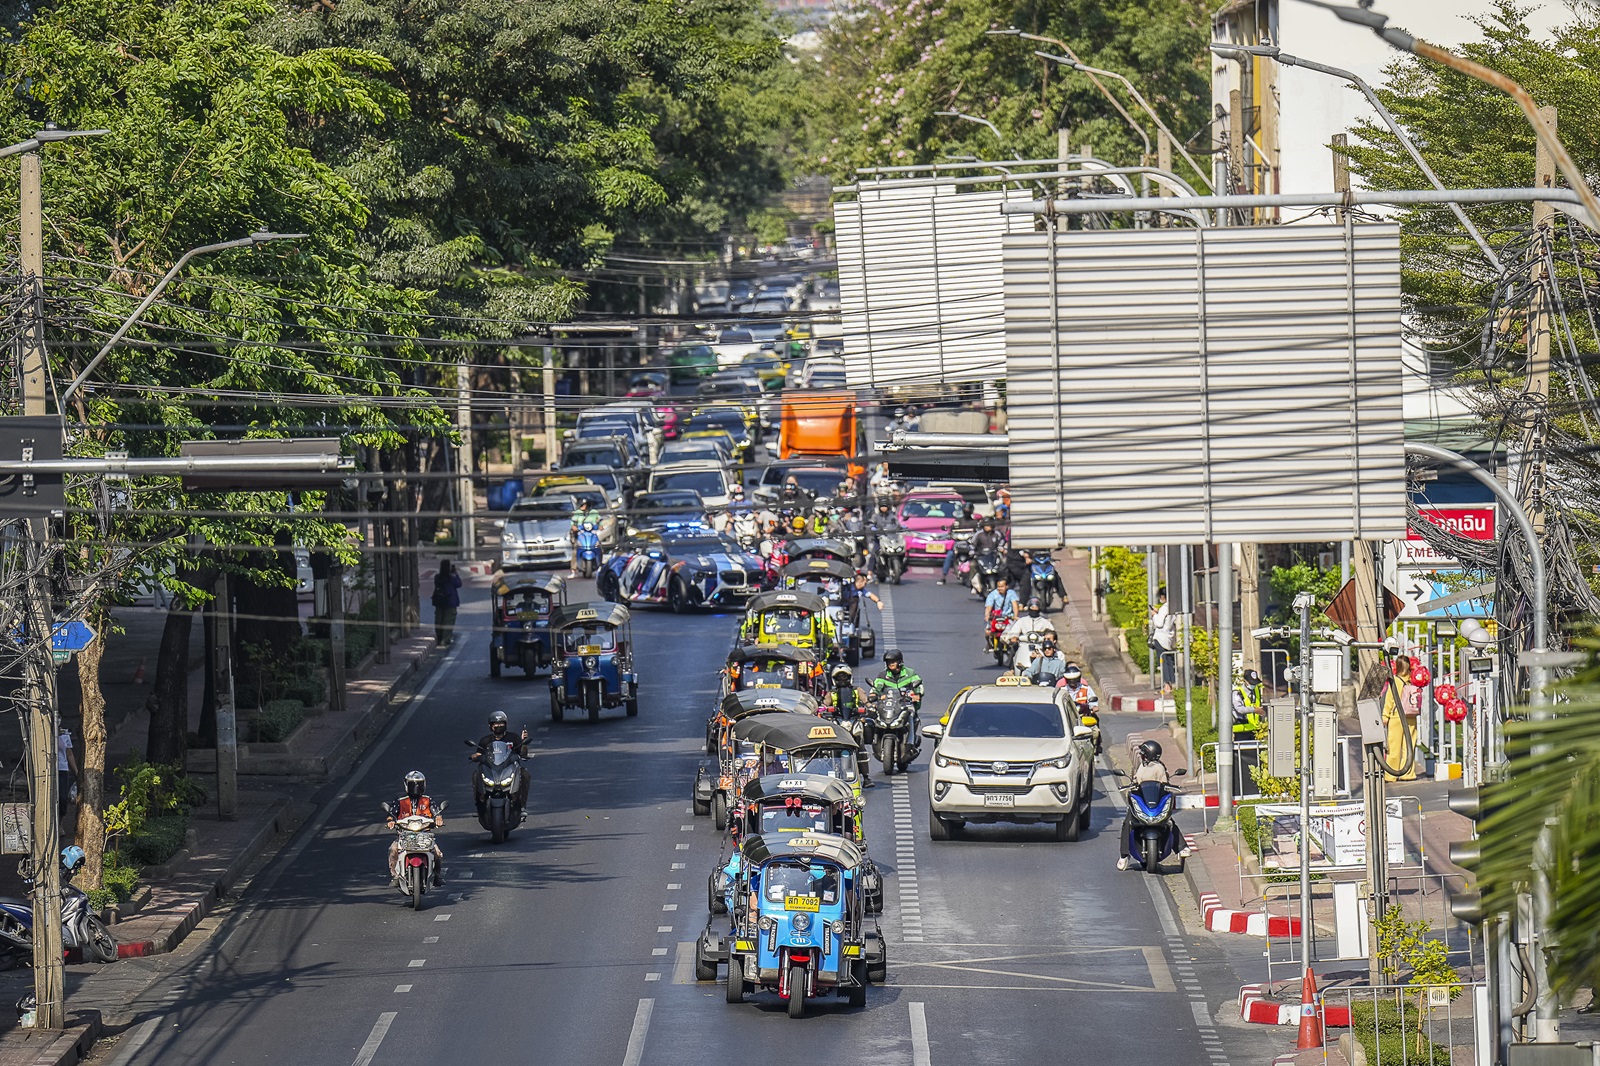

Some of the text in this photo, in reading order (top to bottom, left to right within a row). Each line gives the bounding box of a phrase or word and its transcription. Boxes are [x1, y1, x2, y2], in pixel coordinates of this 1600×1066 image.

[1435, 514, 1486, 531] ฉกเฉิน
[801, 898, 819, 906] 7092
